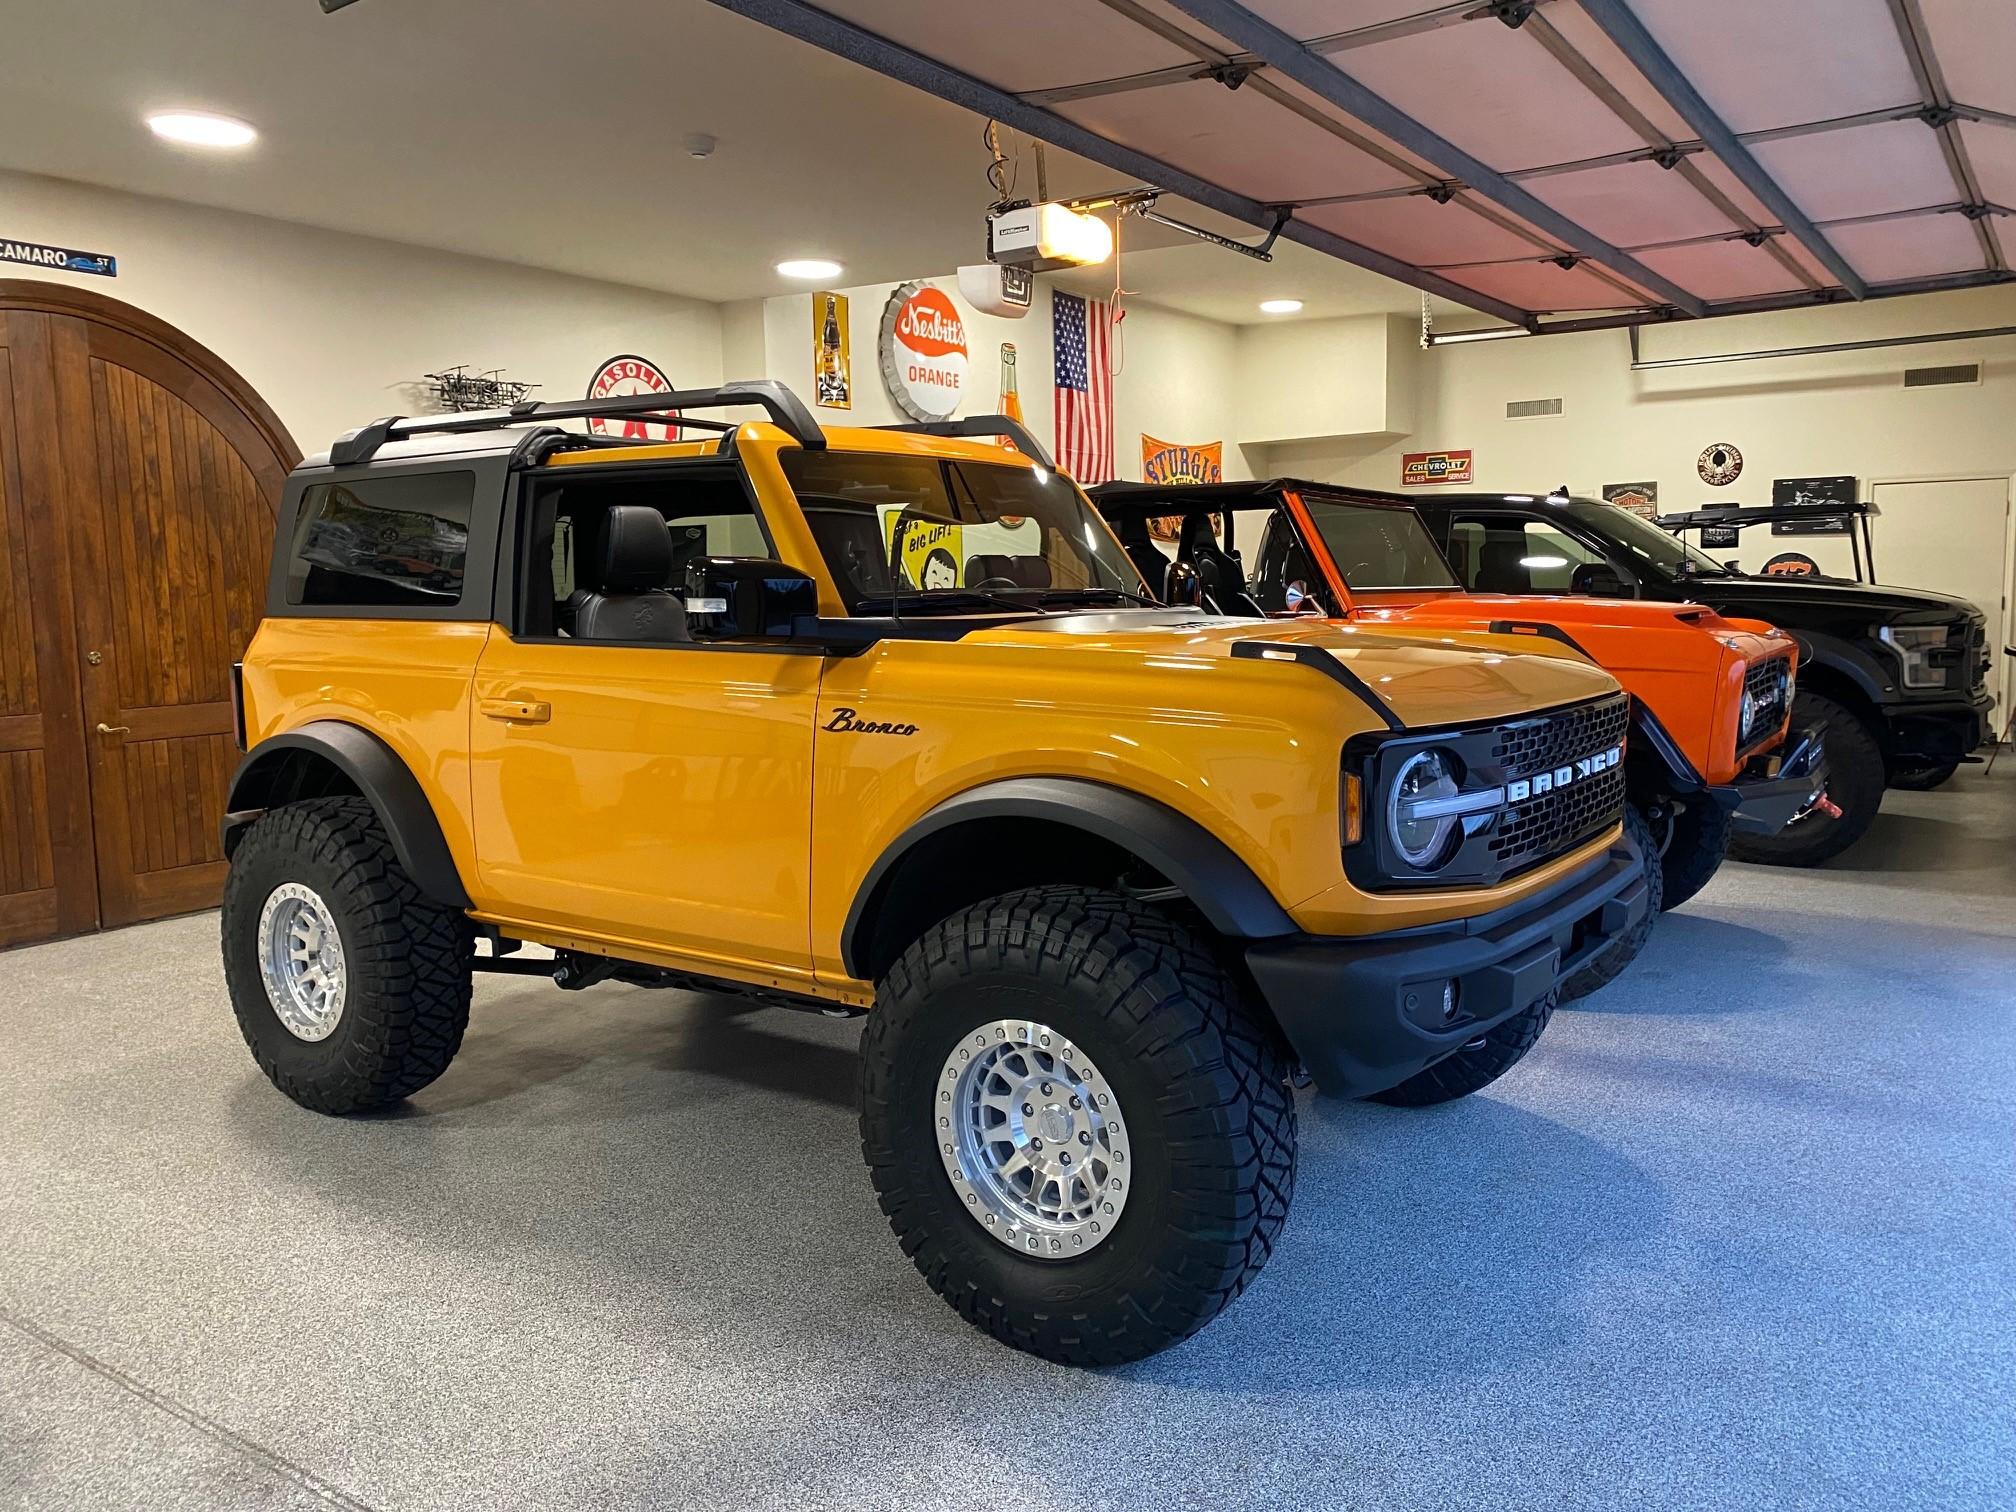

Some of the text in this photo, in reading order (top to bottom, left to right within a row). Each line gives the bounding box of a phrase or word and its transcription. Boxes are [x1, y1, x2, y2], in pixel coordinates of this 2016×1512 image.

[96, 257, 109, 266] ST
[901, 303, 965, 347] Nesbitt's
[908, 366, 960, 389] ORANGE
[1145, 448, 1220, 484] STURGIS
[1411, 461, 1462, 471] CHEVROLET
[1448, 472, 1470, 480] SERVICE
[909, 534, 926, 552] BIG
[929, 525, 951, 544] LIFT!
[821, 707, 920, 736] Bronco
